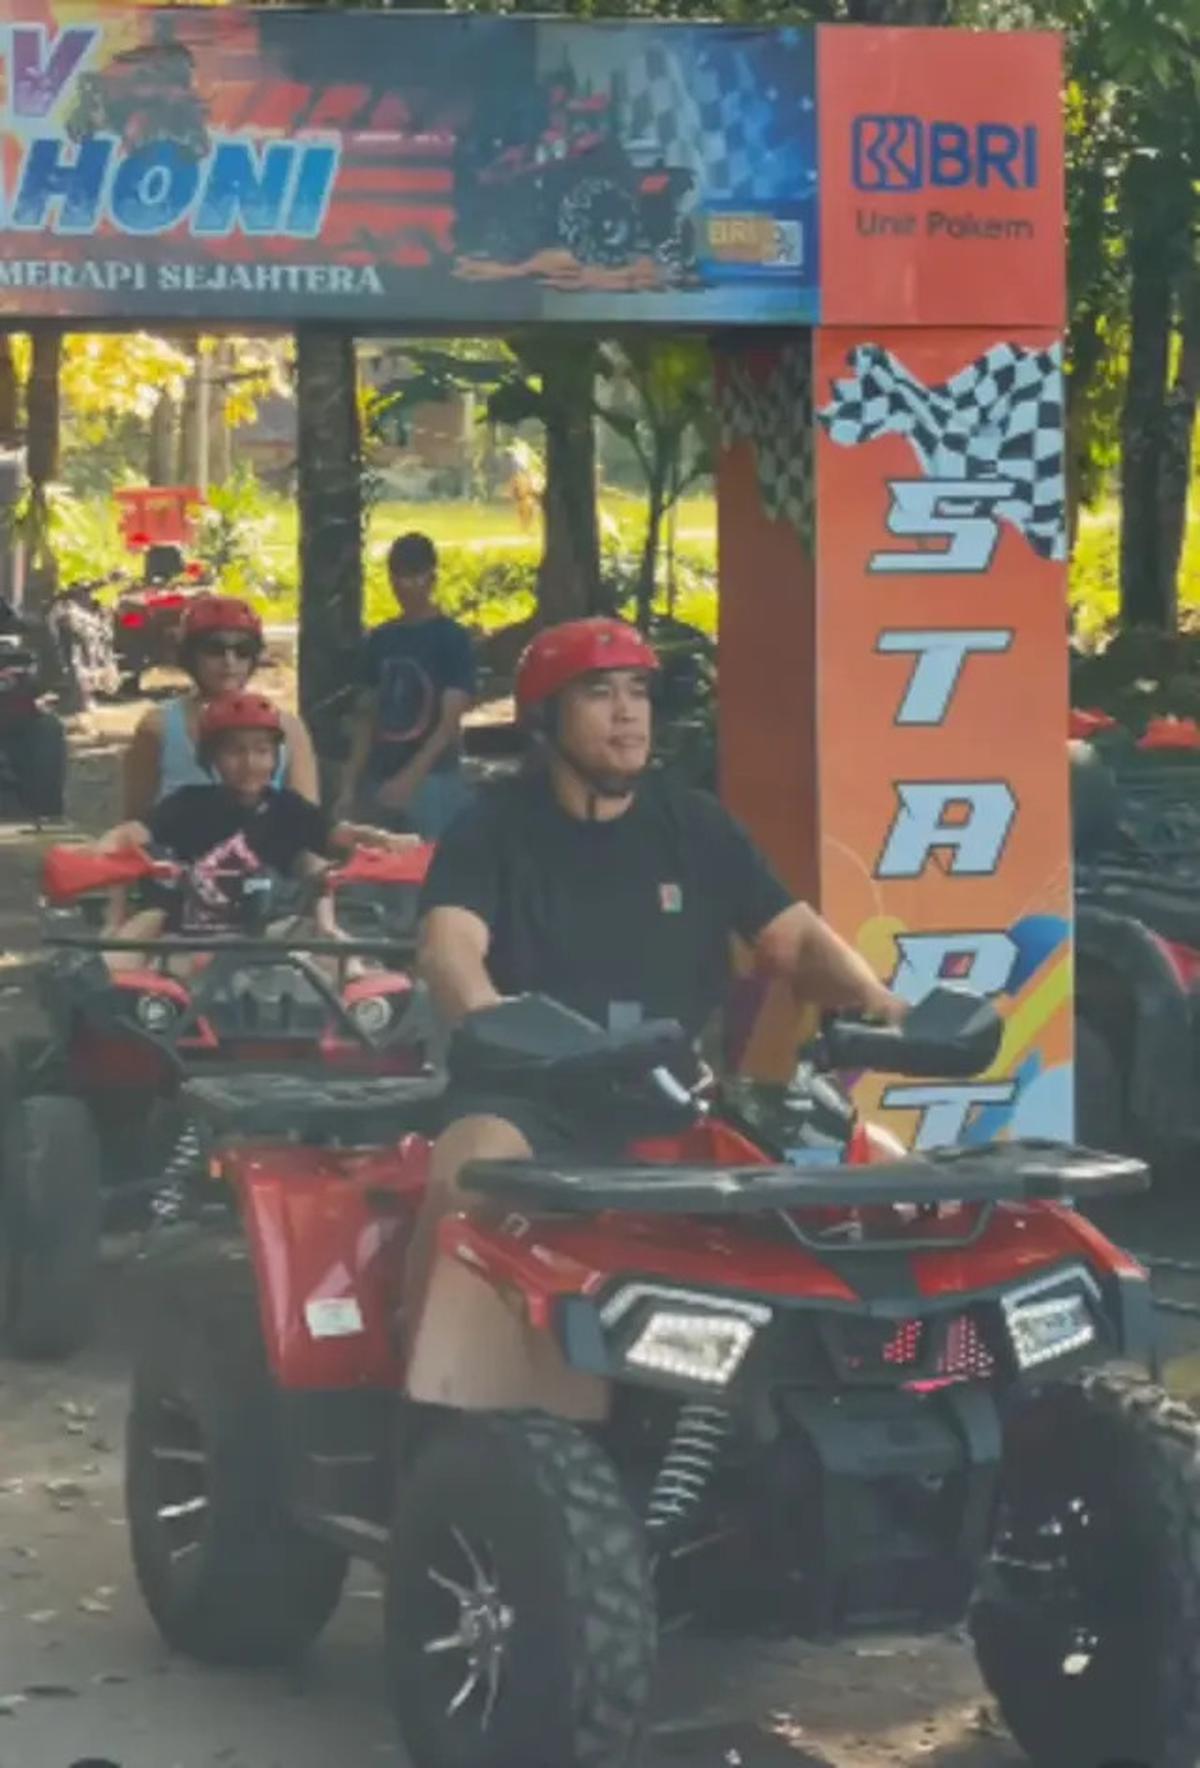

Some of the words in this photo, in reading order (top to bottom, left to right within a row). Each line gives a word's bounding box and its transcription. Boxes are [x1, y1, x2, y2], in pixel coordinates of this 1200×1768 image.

[0, 23, 101, 119] V
[0, 130, 342, 237] HONI
[930, 121, 1037, 188] BRI
[0, 259, 147, 291] MERAPI
[158, 265, 384, 295] SEJAHTERA
